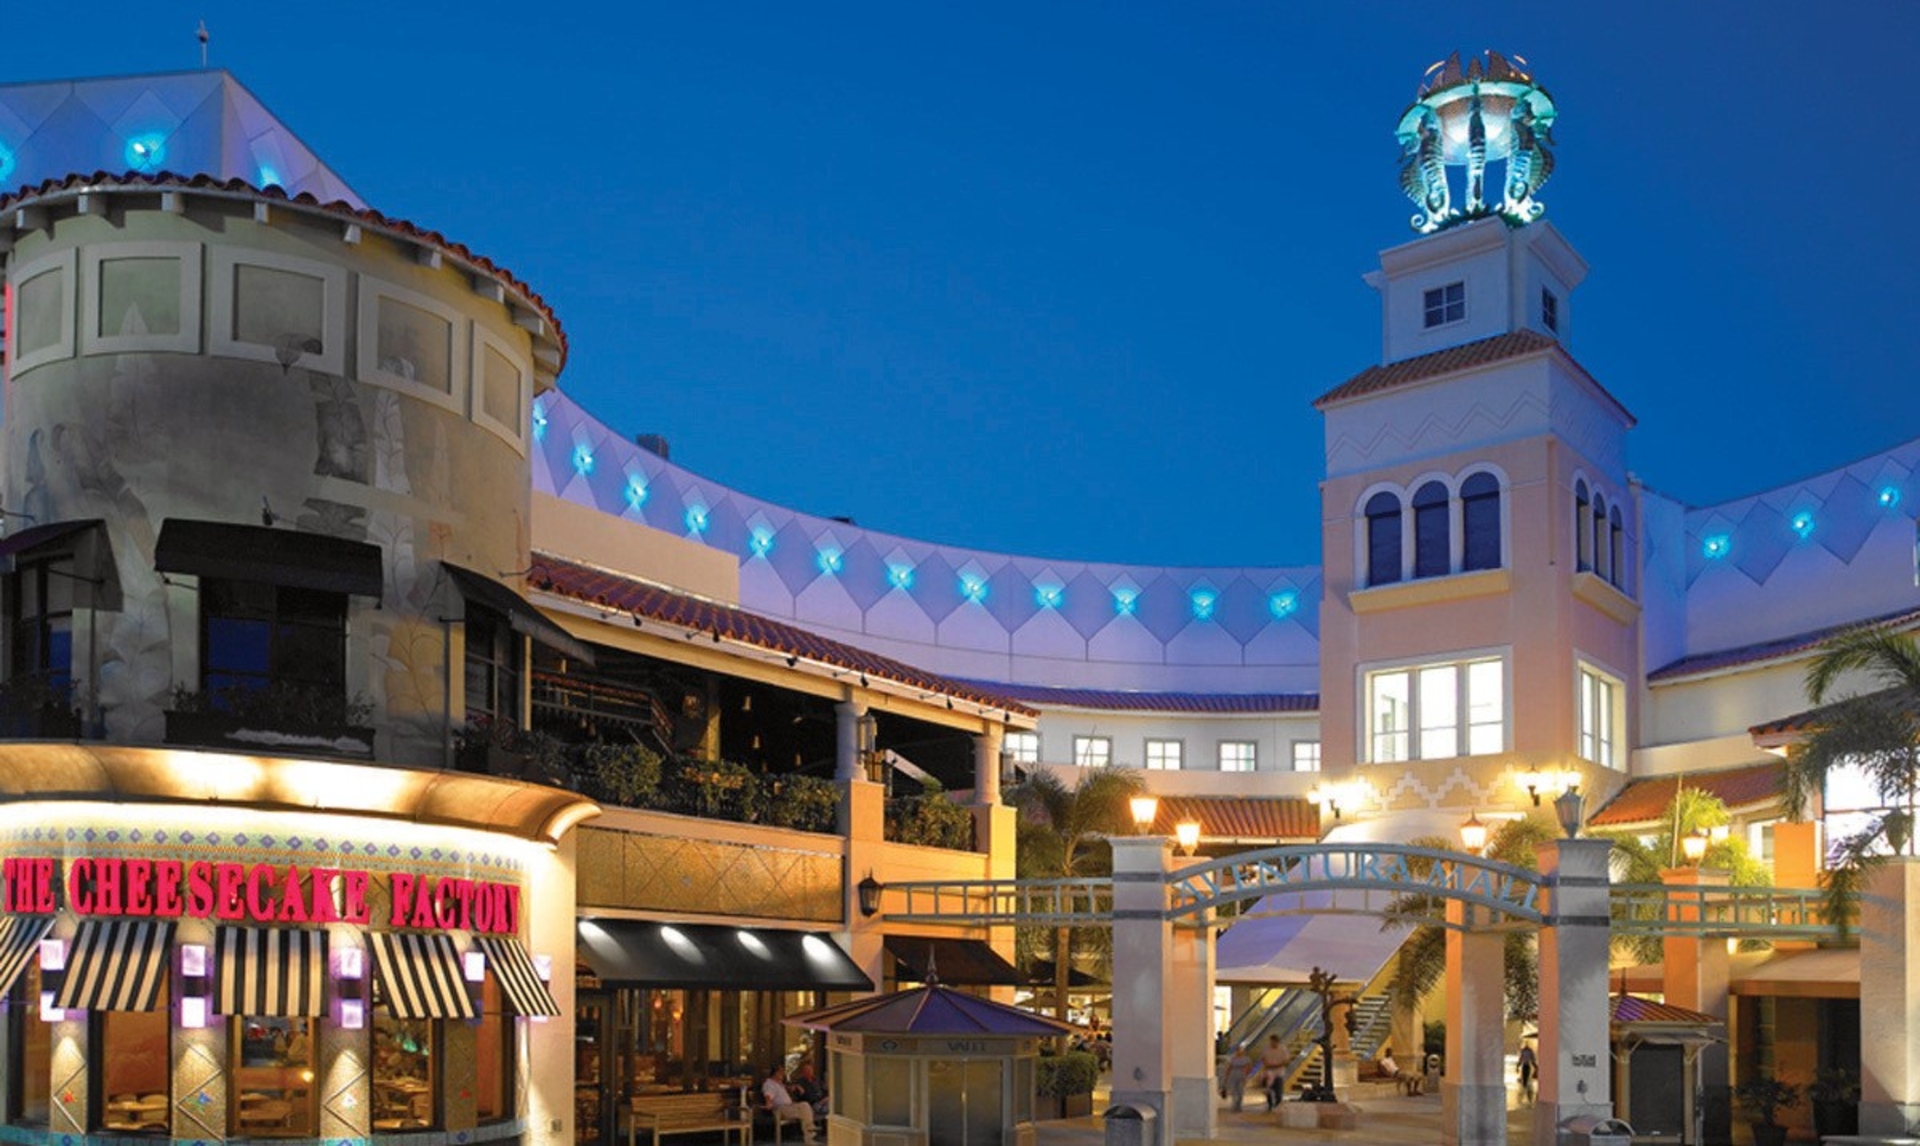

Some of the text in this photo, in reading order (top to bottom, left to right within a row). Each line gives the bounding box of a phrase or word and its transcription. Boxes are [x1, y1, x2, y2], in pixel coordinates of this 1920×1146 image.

[3, 857, 521, 935] THE CHEESECAKE FACTORY
[1178, 851, 1542, 911] AVENTURA MALL
